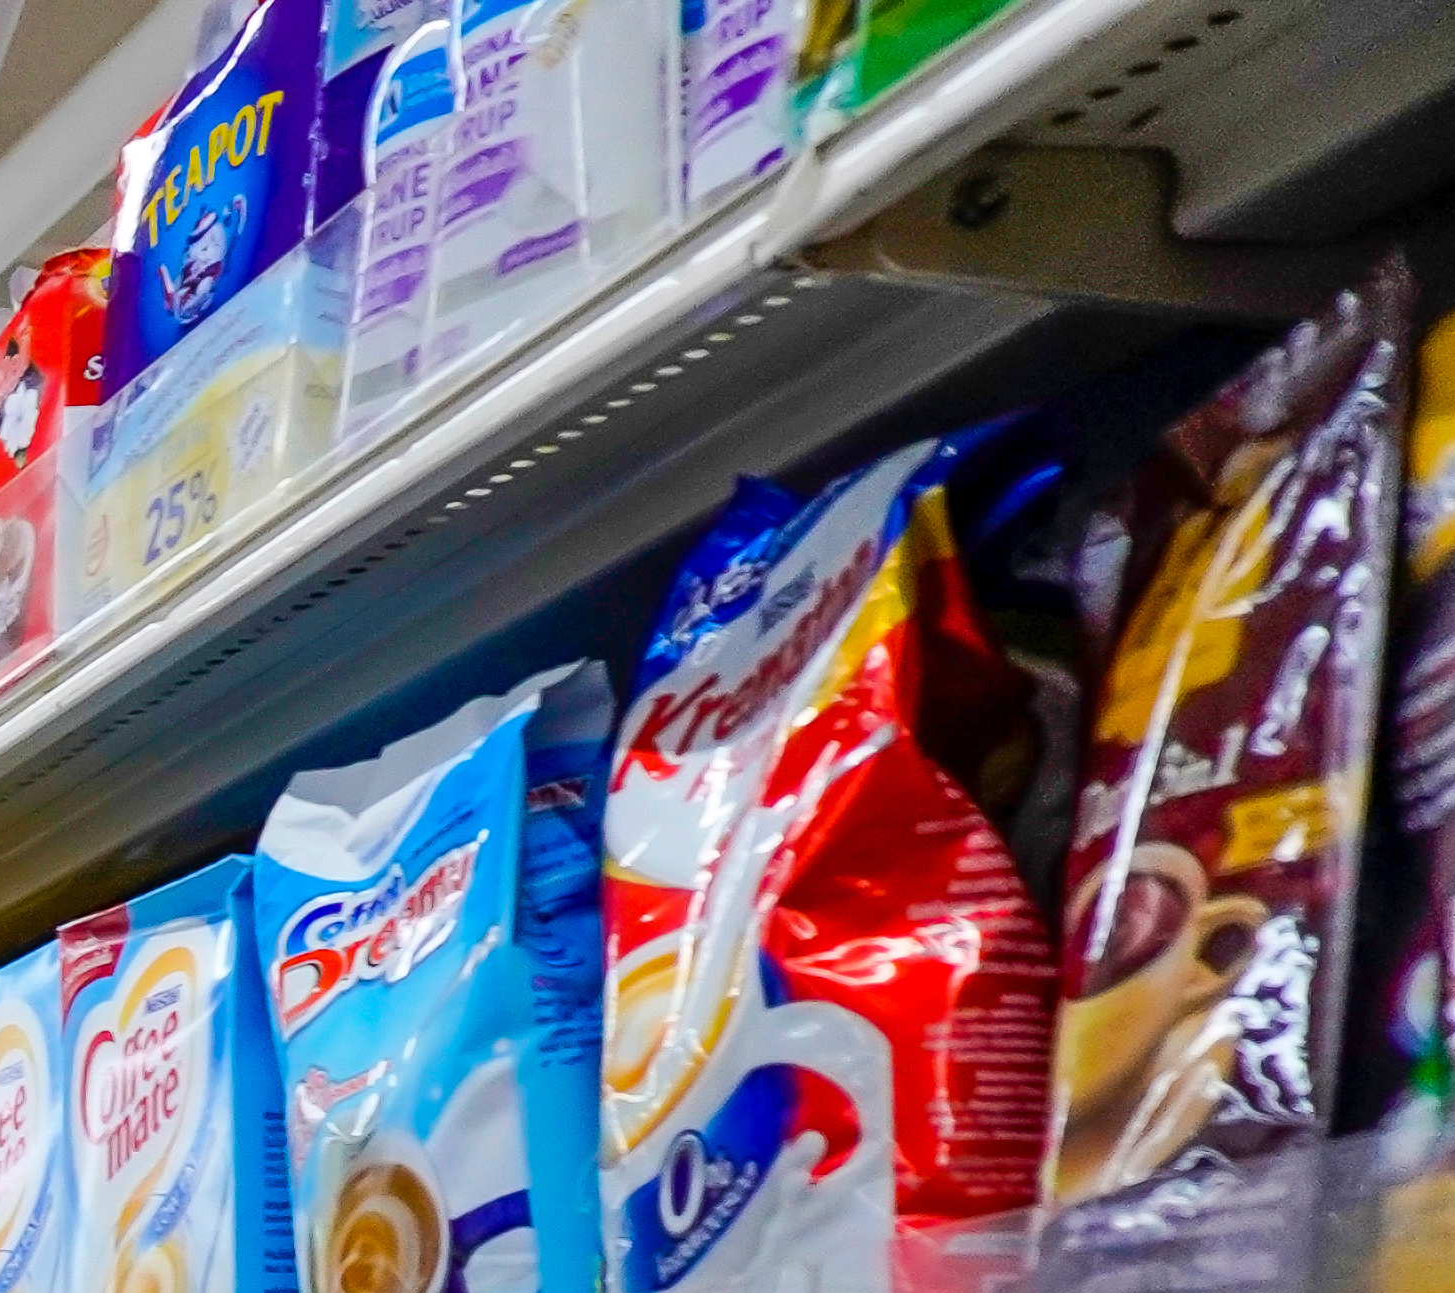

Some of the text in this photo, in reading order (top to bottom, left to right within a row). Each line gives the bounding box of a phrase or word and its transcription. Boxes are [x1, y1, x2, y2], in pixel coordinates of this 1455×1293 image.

[141, 89, 284, 249] TEAPOT
[142, 460, 218, 568] 25%
[81, 1007, 180, 1143] Coffee
[103, 1061, 180, 1181] mate
